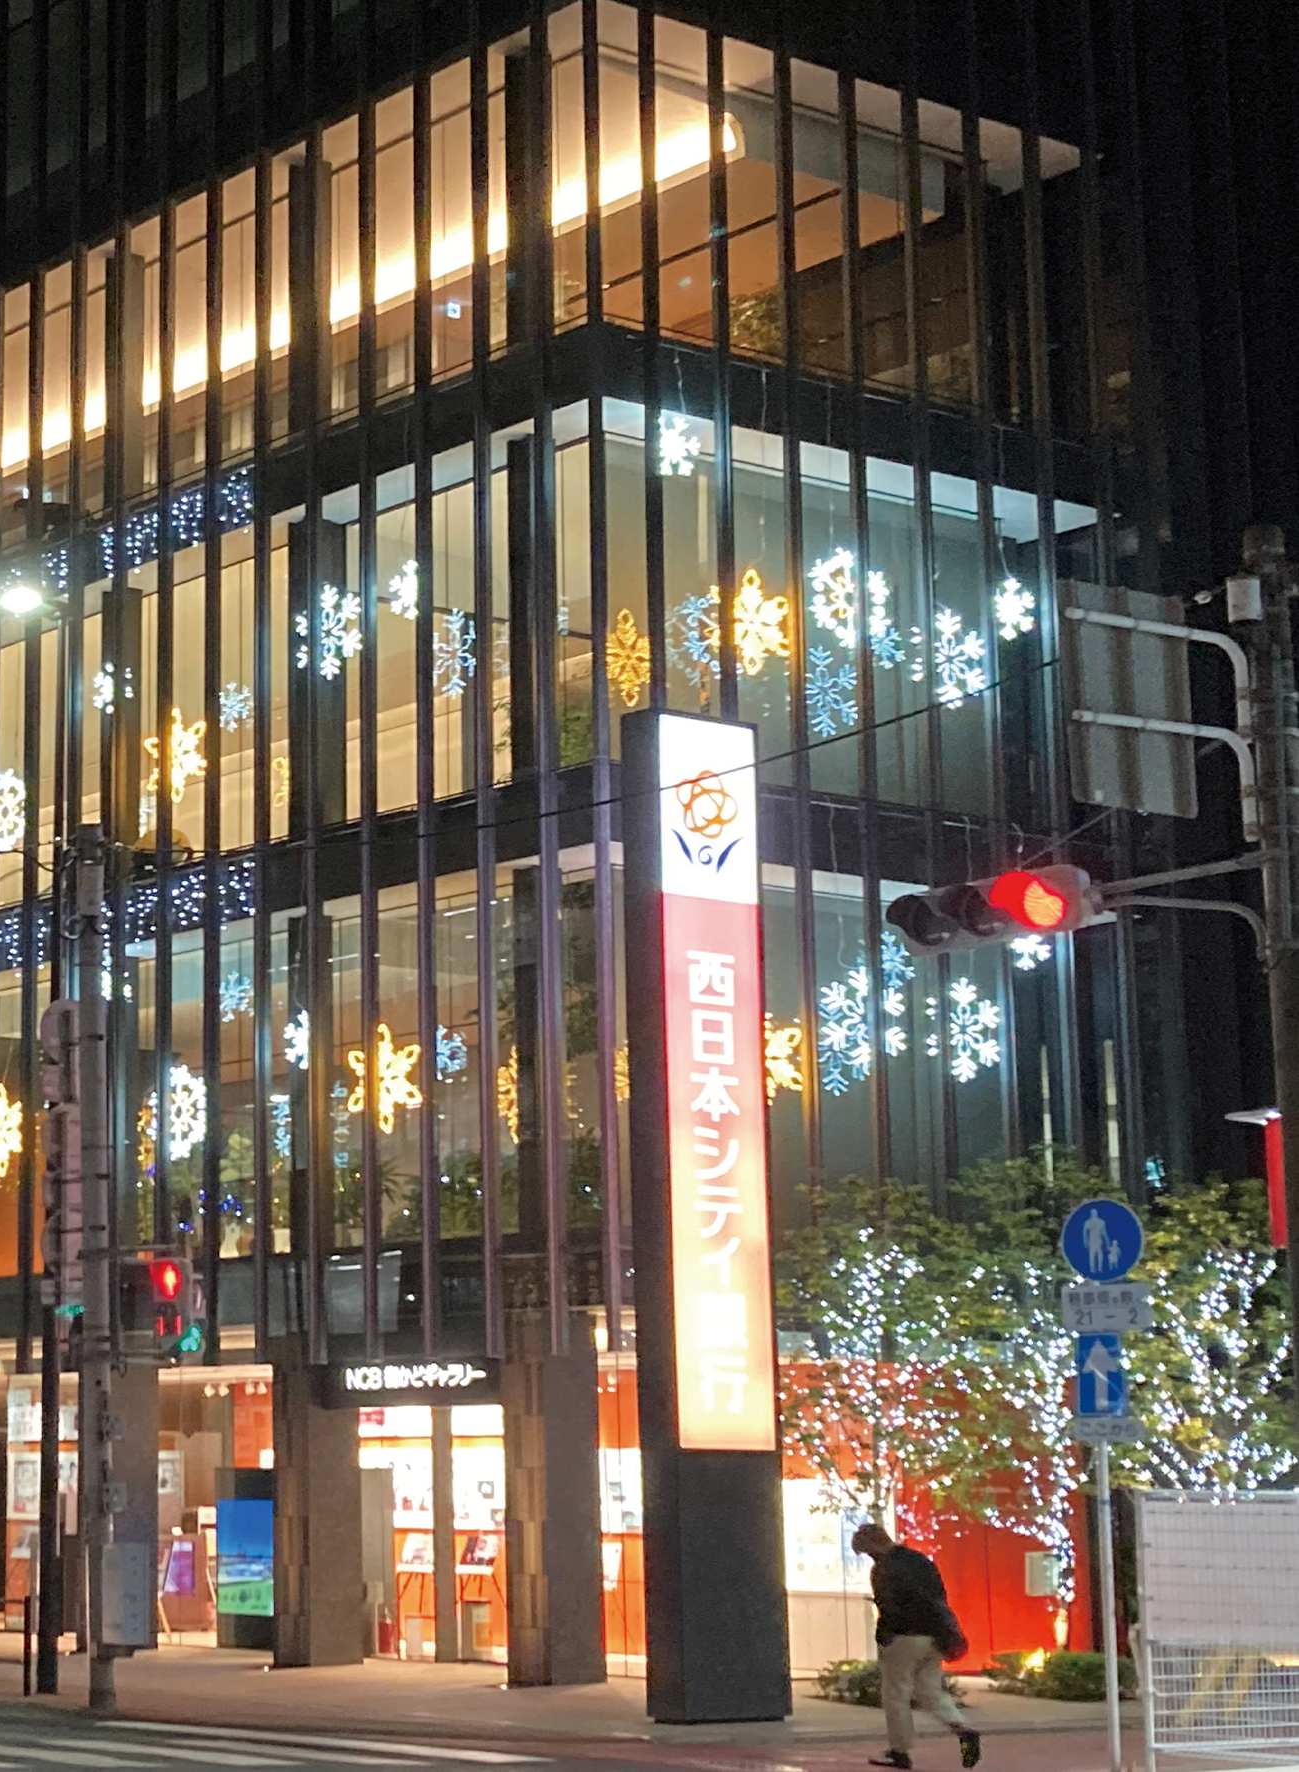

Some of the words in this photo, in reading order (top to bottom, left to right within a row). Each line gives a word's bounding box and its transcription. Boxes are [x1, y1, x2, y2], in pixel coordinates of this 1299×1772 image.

[687, 949, 748, 1414] 西日本シティ行
[346, 1366, 382, 1390] NCB
[1081, 1422, 1139, 1438] ここから
